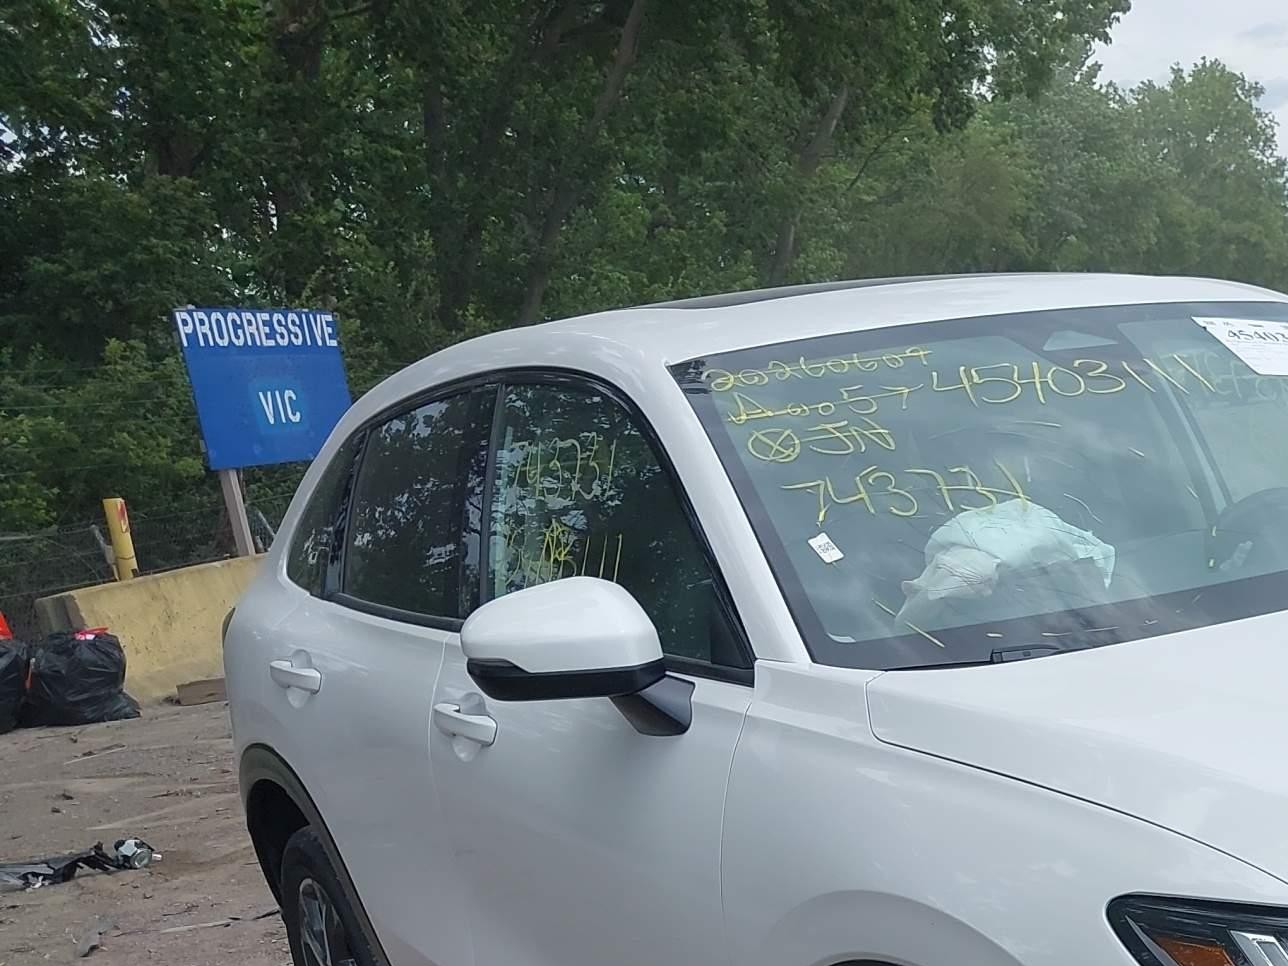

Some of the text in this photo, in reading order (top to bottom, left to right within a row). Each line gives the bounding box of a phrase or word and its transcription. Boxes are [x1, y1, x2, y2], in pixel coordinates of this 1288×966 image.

[175, 311, 338, 347] PROGRESSIVE
[932, 354, 1216, 407] 45403111
[258, 389, 301, 425] VIC
